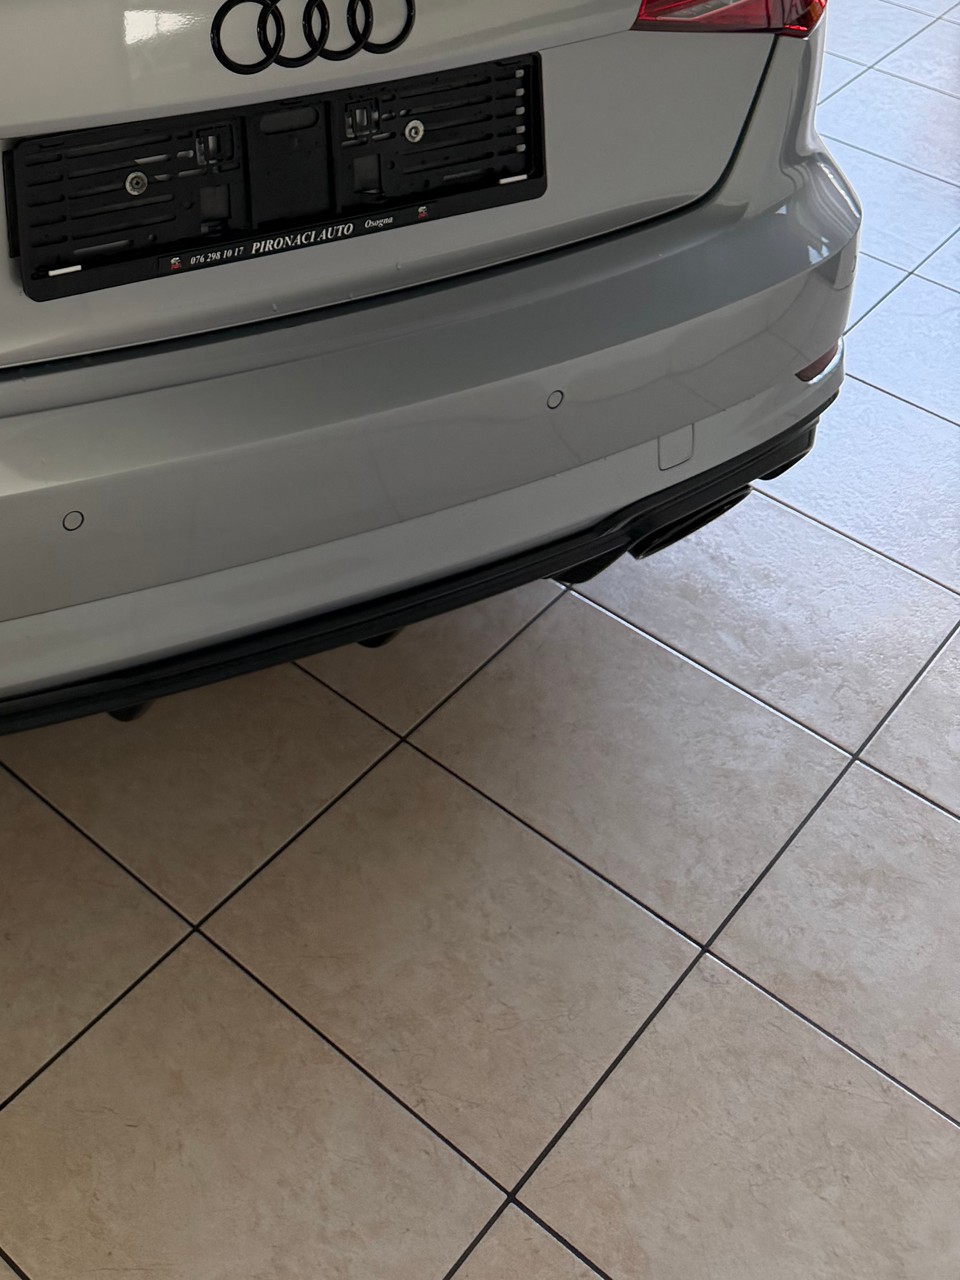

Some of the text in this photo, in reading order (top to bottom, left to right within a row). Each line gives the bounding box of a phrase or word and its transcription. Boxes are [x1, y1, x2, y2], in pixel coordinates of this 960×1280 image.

[190, 216, 394, 265] 076 298 10 17 PIRONACI AUTO Osogna
